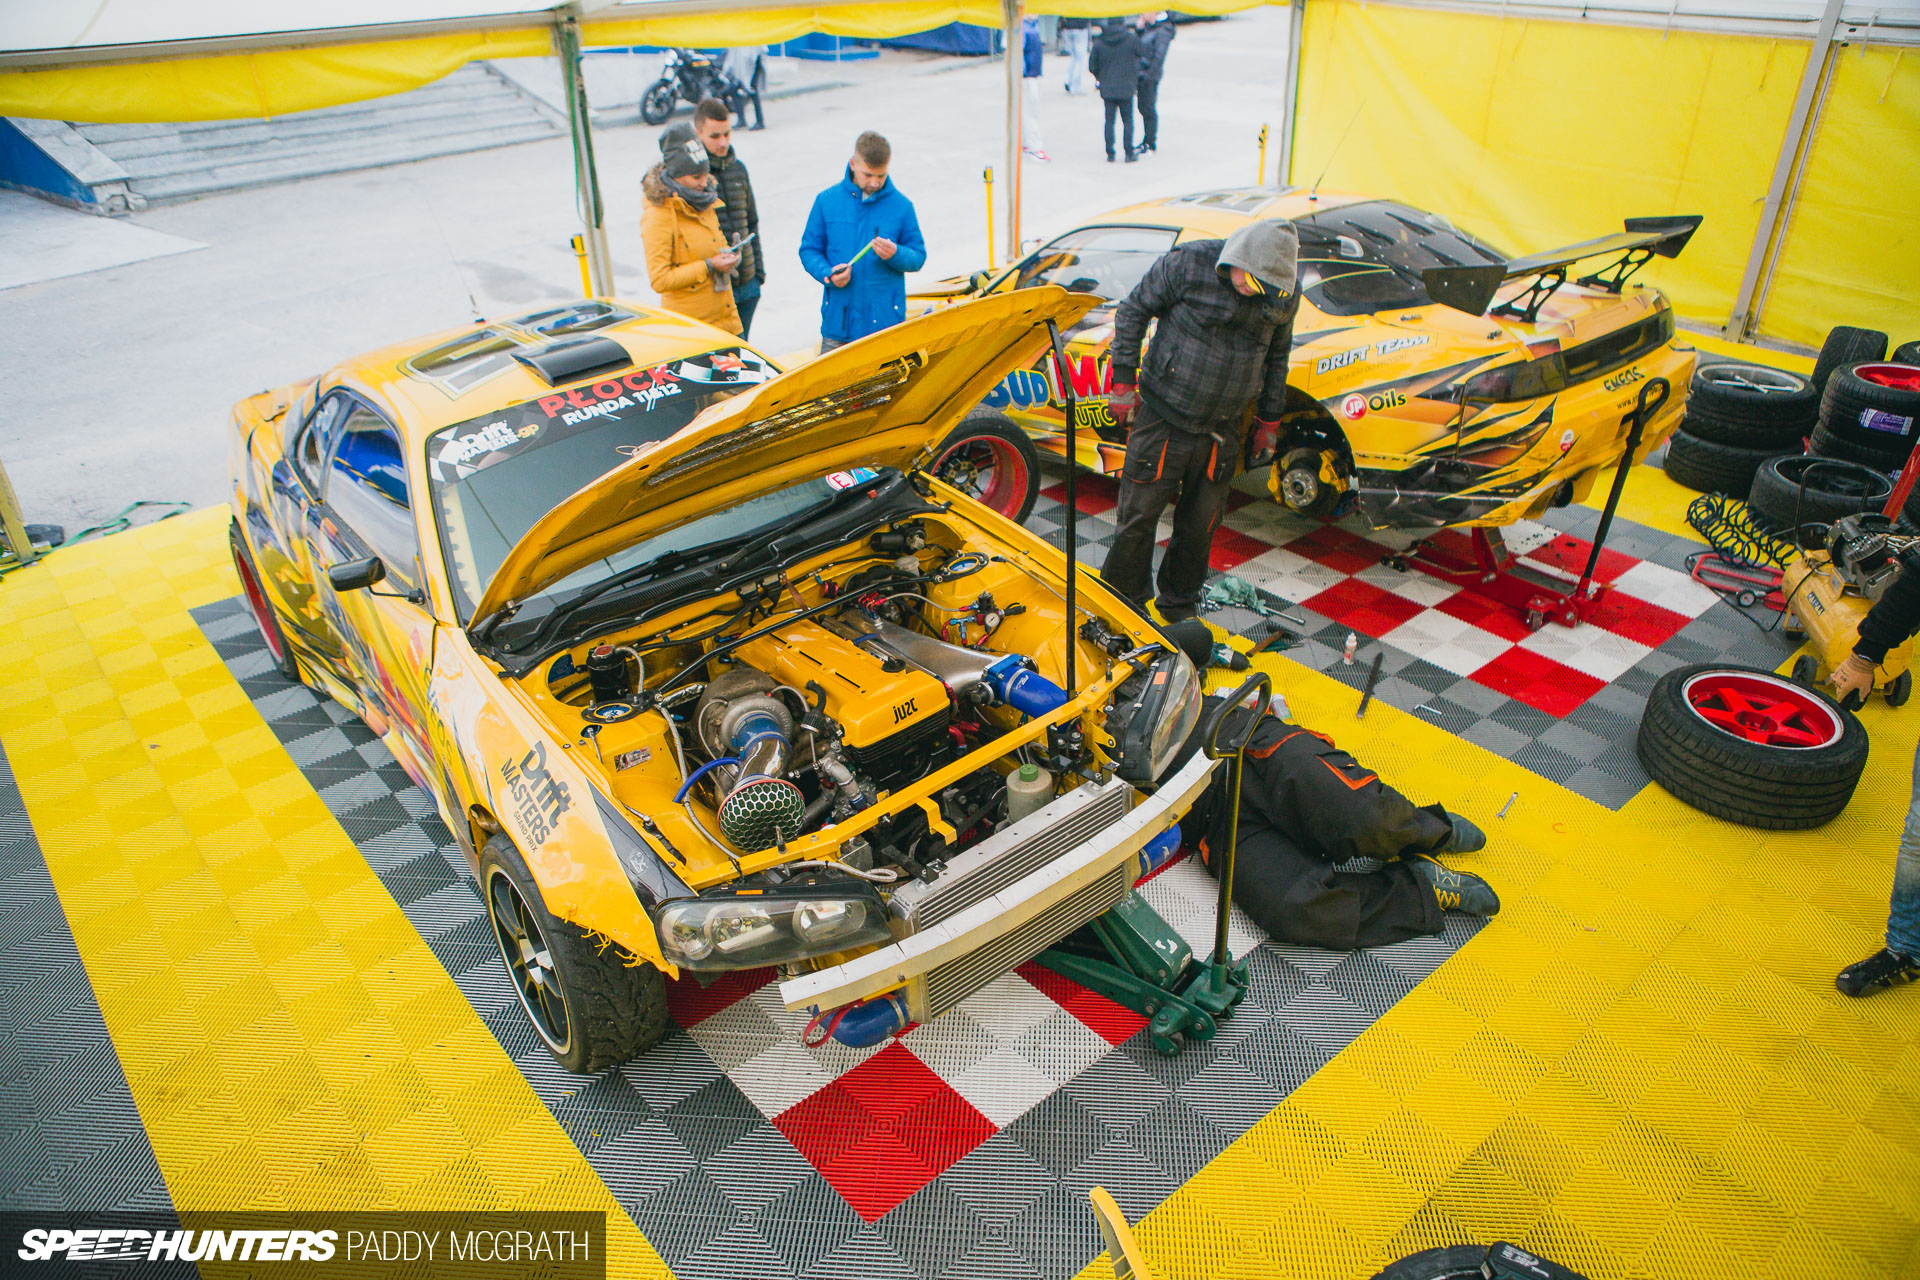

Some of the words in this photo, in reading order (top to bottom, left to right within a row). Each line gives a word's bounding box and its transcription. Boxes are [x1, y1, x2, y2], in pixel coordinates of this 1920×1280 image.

[1316, 345, 1370, 375] DRIFT
[1376, 335, 1429, 356] TEAM
[538, 364, 681, 418] PŁOCK
[1603, 366, 1645, 392] ENEOS
[562, 396, 635, 426] RUNDA
[1348, 401, 1363, 414] JP
[1368, 390, 1407, 411] Oils
[520, 740, 572, 829] Drift
[500, 757, 550, 845] MASTERS
[513, 810, 528, 836] GRAND
[525, 835, 539, 852] PRIX
